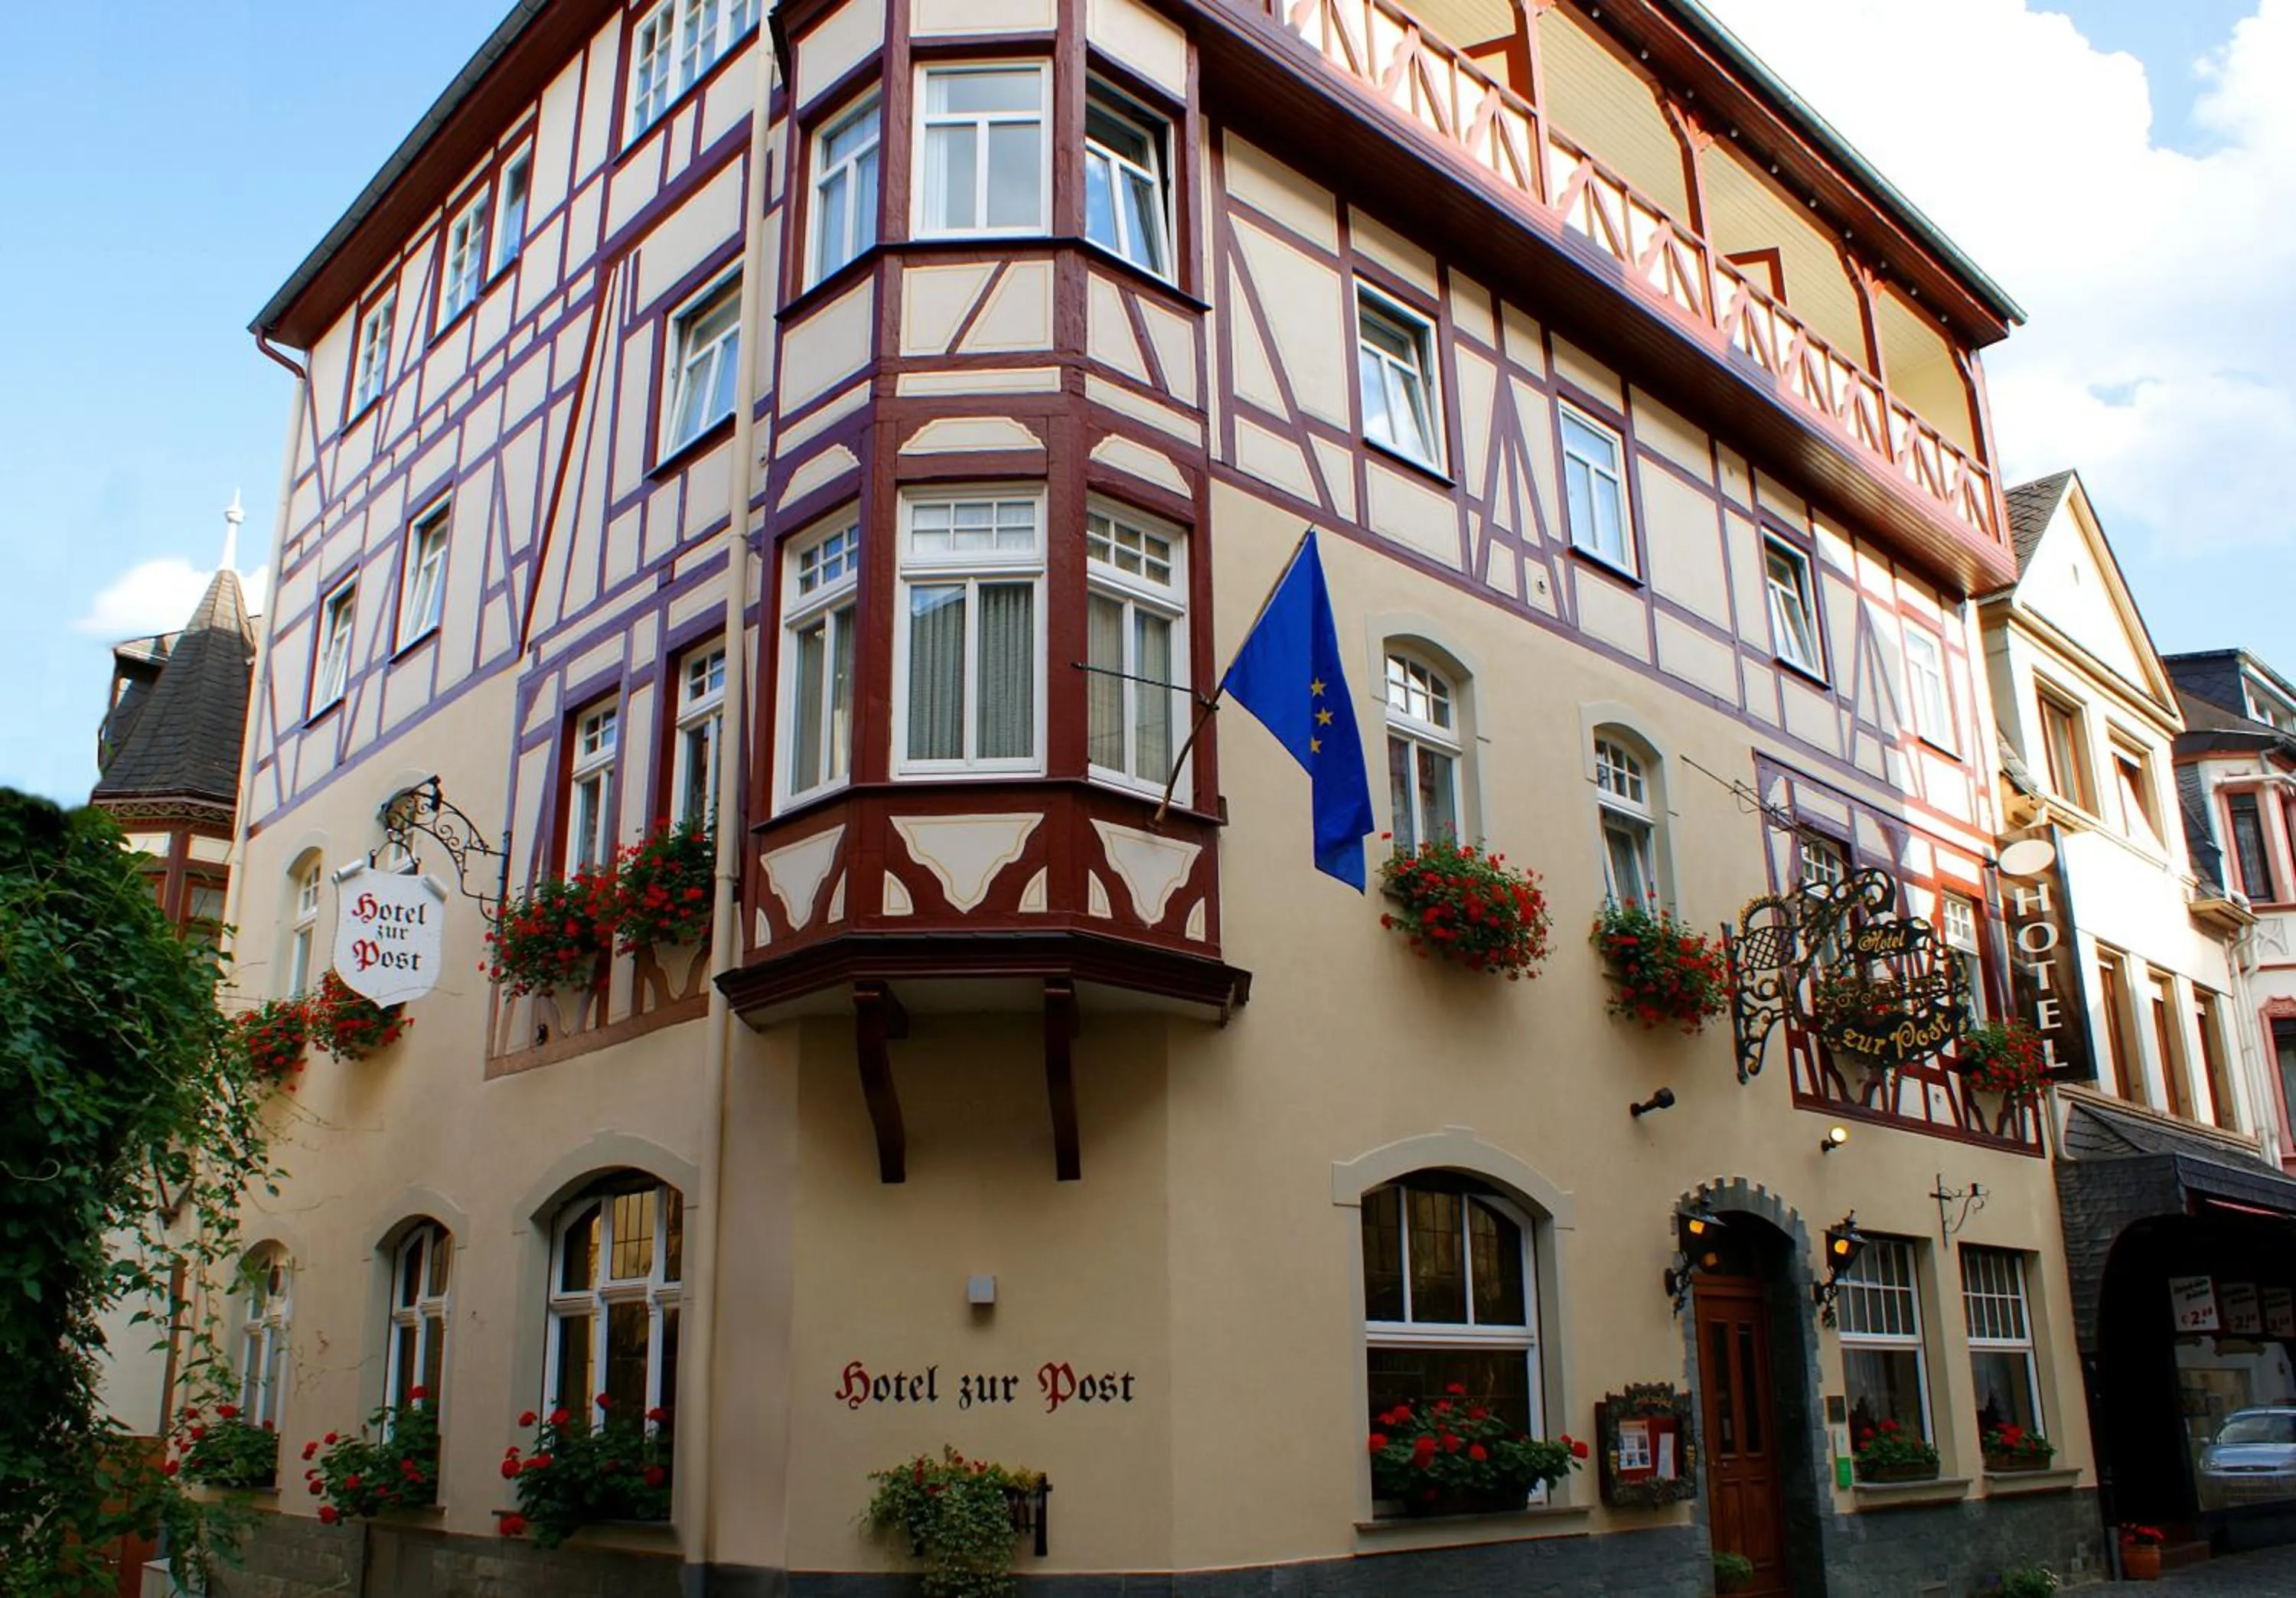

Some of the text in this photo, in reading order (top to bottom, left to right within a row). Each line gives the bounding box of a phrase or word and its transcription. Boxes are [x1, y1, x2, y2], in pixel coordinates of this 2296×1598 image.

[351, 892, 428, 925] Hotel
[375, 924, 409, 940] zur
[1857, 928, 1906, 951] Hotel
[351, 938, 422, 973] Post
[2014, 882, 2069, 1068] HOTEL
[1842, 1012, 1952, 1060] zur Post
[835, 1361, 1135, 1414] Hotel zur Post
